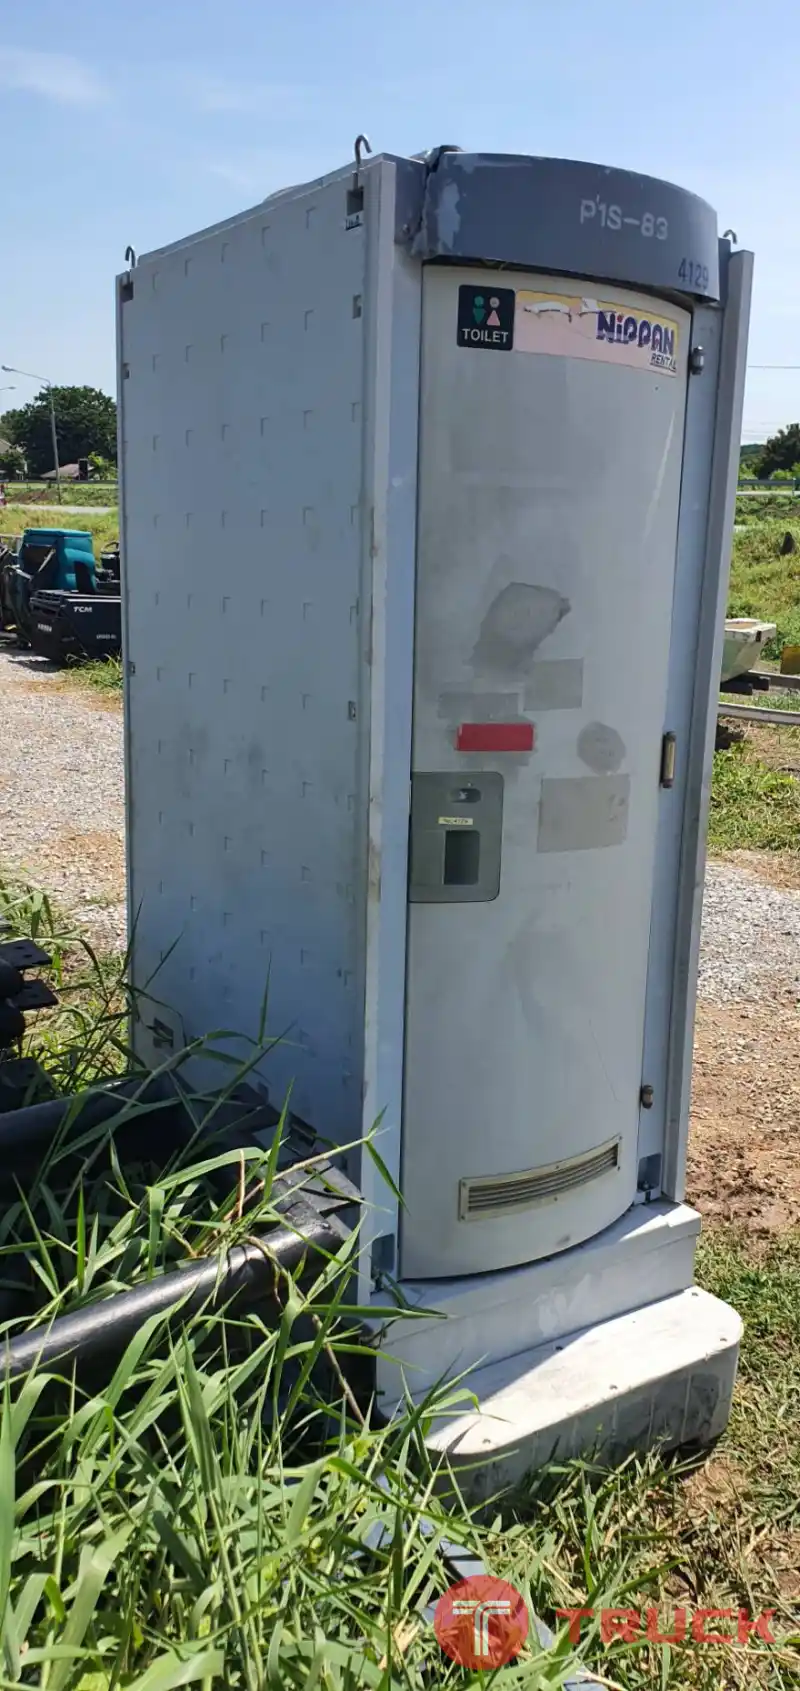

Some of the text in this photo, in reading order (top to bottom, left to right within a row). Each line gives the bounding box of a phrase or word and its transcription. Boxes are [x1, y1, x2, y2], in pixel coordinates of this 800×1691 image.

[678, 257, 709, 290] 4129
[462, 328, 509, 343] TOILET
[651, 352, 677, 370] RENTAL
